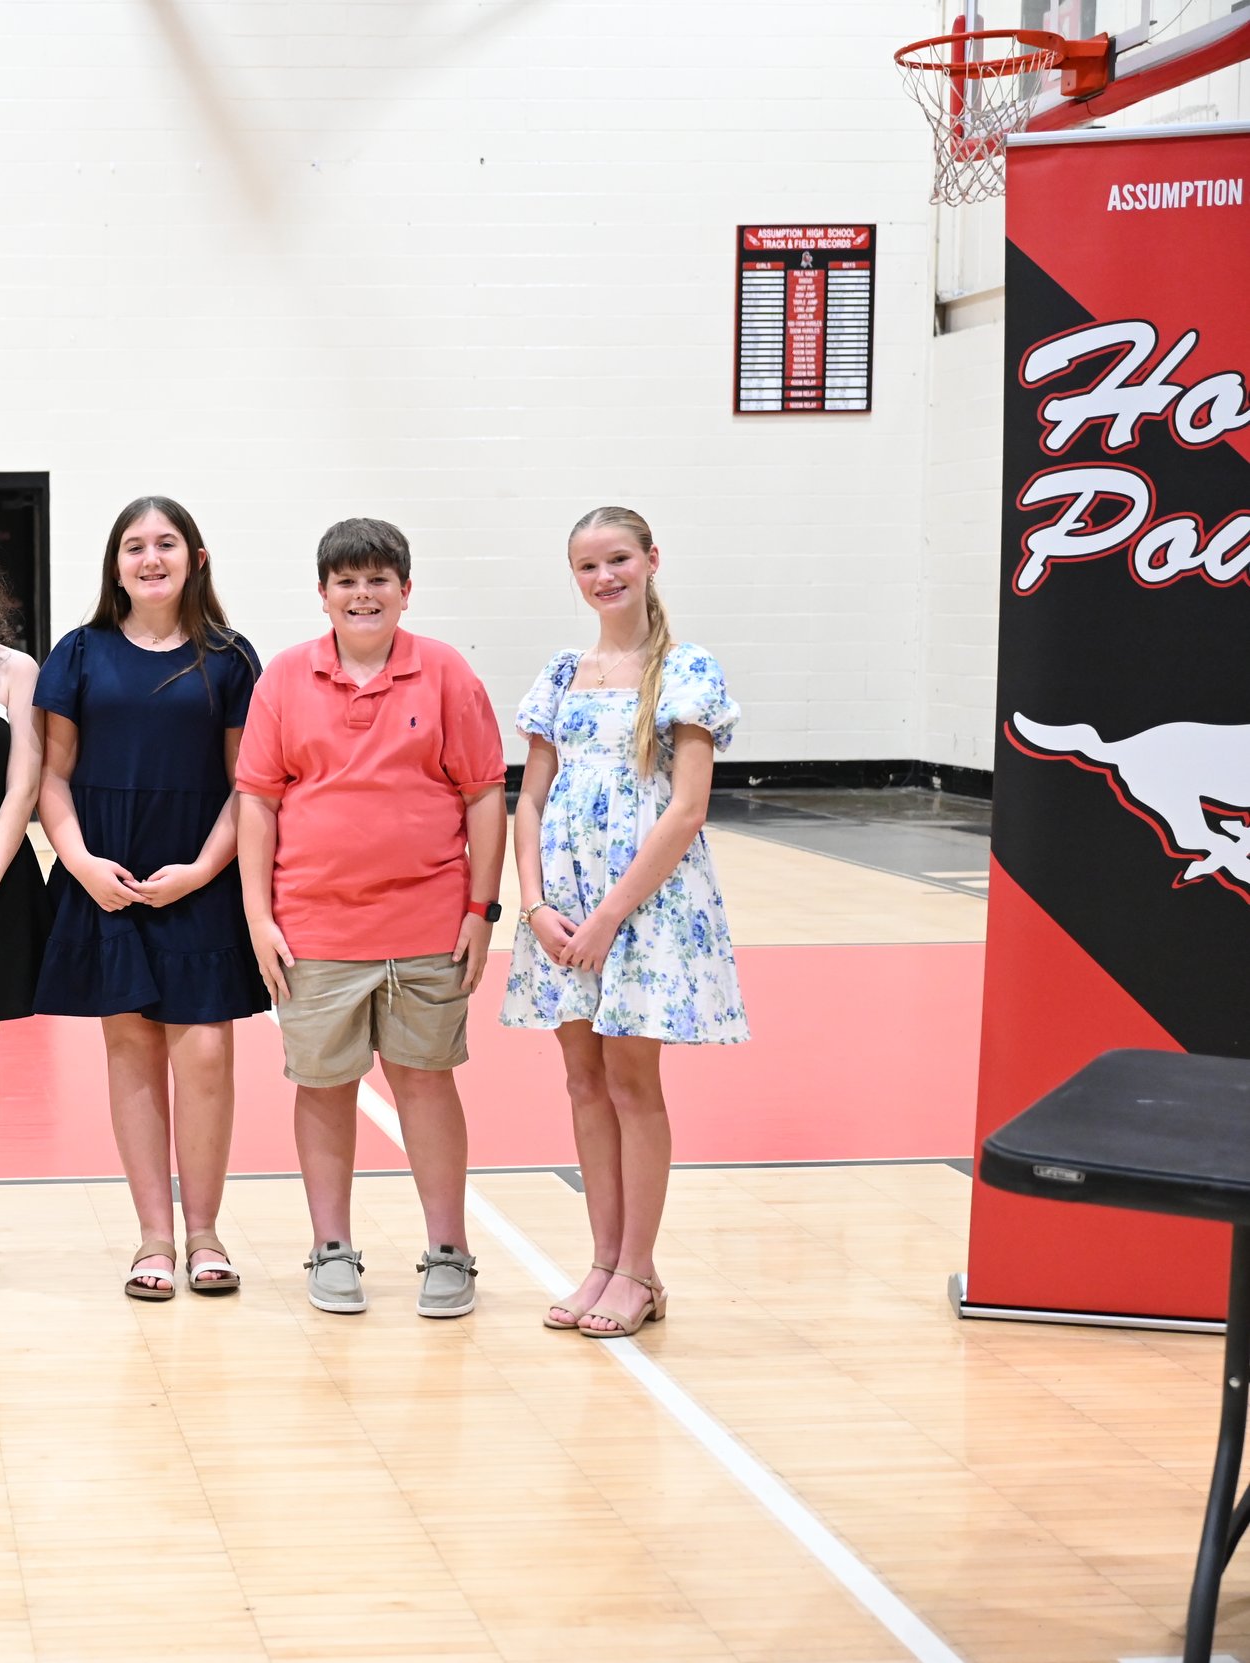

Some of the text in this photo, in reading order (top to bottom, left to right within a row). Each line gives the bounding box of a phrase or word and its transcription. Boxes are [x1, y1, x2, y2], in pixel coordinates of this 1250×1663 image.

[1107, 178, 1243, 211] ASSUMPTION
[758, 228, 856, 238] ASSUMPTION HIGH SCHOOL
[762, 239, 851, 249] TRACK & FIELD RECORDS
[1022, 319, 1250, 453] Ho
